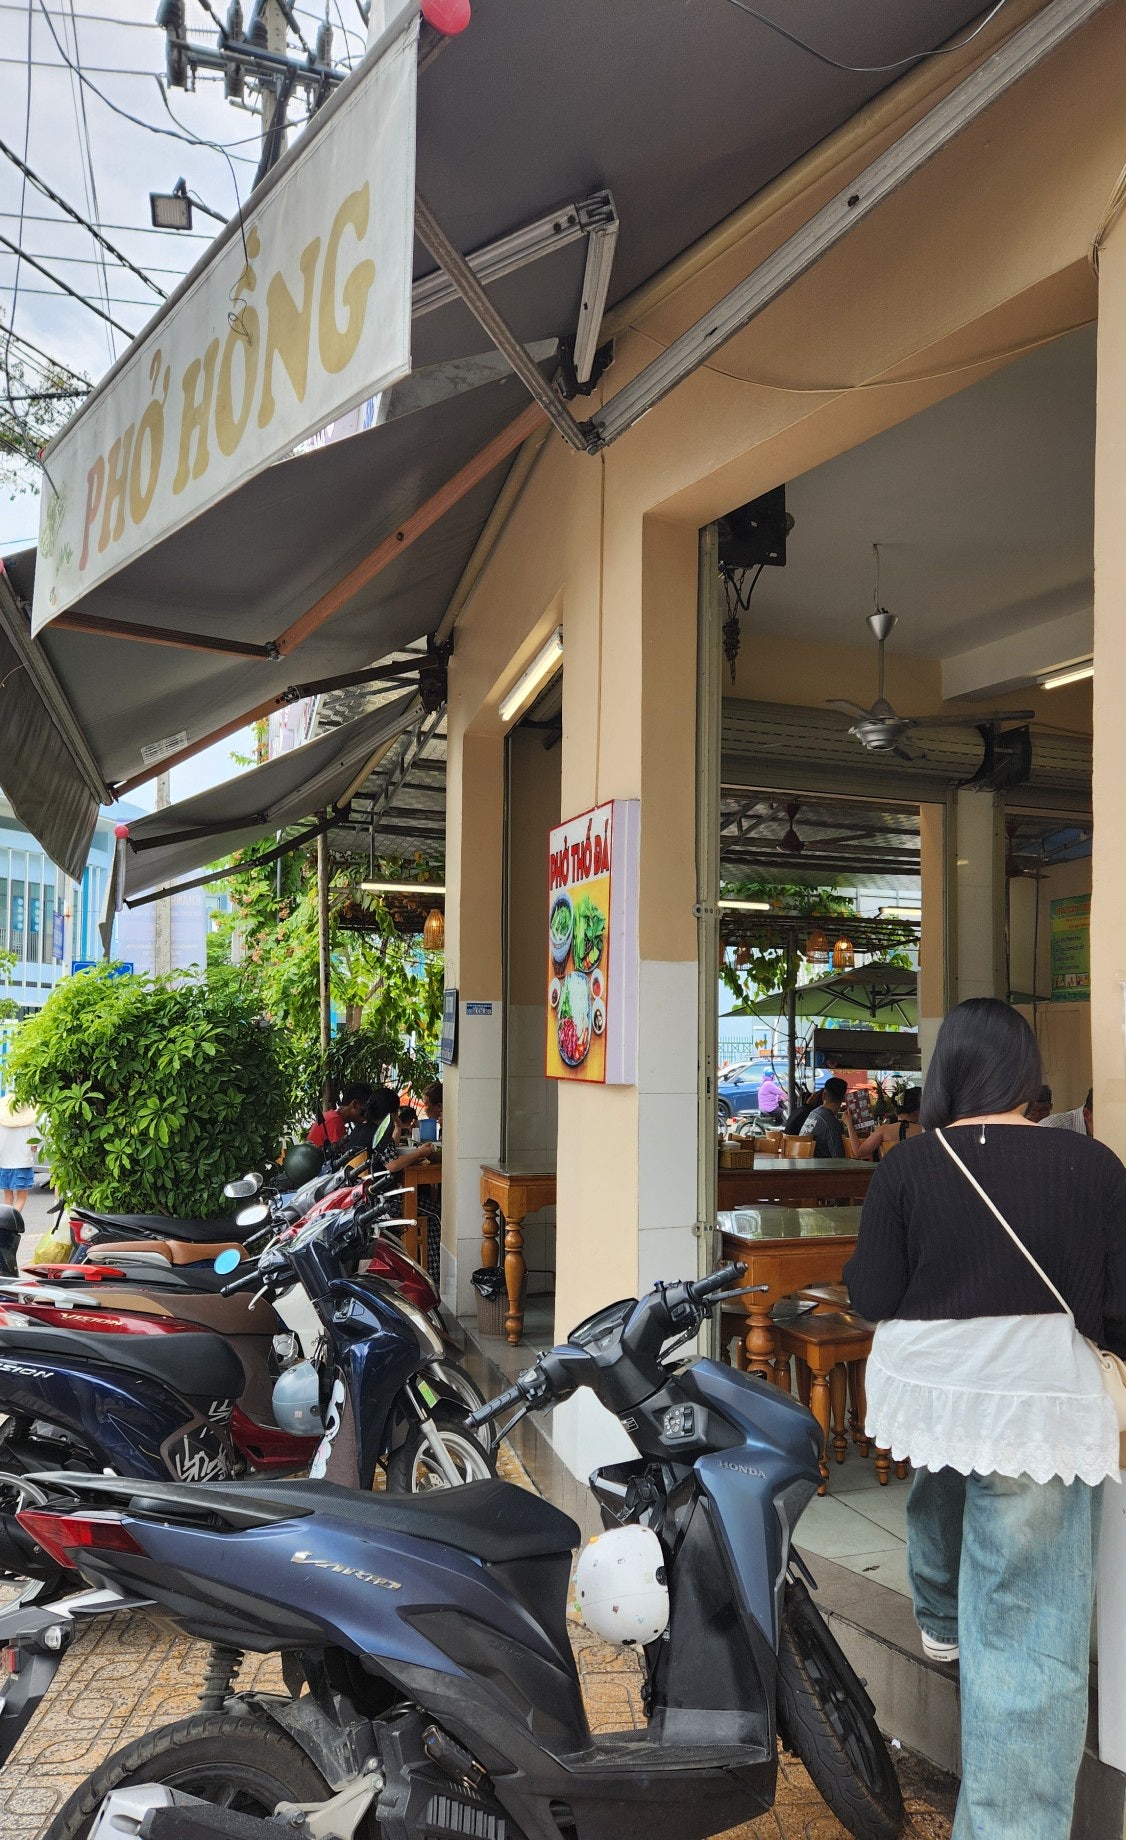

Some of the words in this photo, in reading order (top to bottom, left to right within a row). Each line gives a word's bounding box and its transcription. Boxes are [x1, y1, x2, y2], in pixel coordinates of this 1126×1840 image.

[79, 348, 171, 572] PHỞ
[173, 180, 376, 496] HỒNG
[550, 835, 570, 891] PHỞ
[571, 817, 593, 883] THỐ
[60, 1312, 122, 1327] VISION
[0, 1361, 55, 1380] SION
[718, 1459, 768, 1480] HONDA
